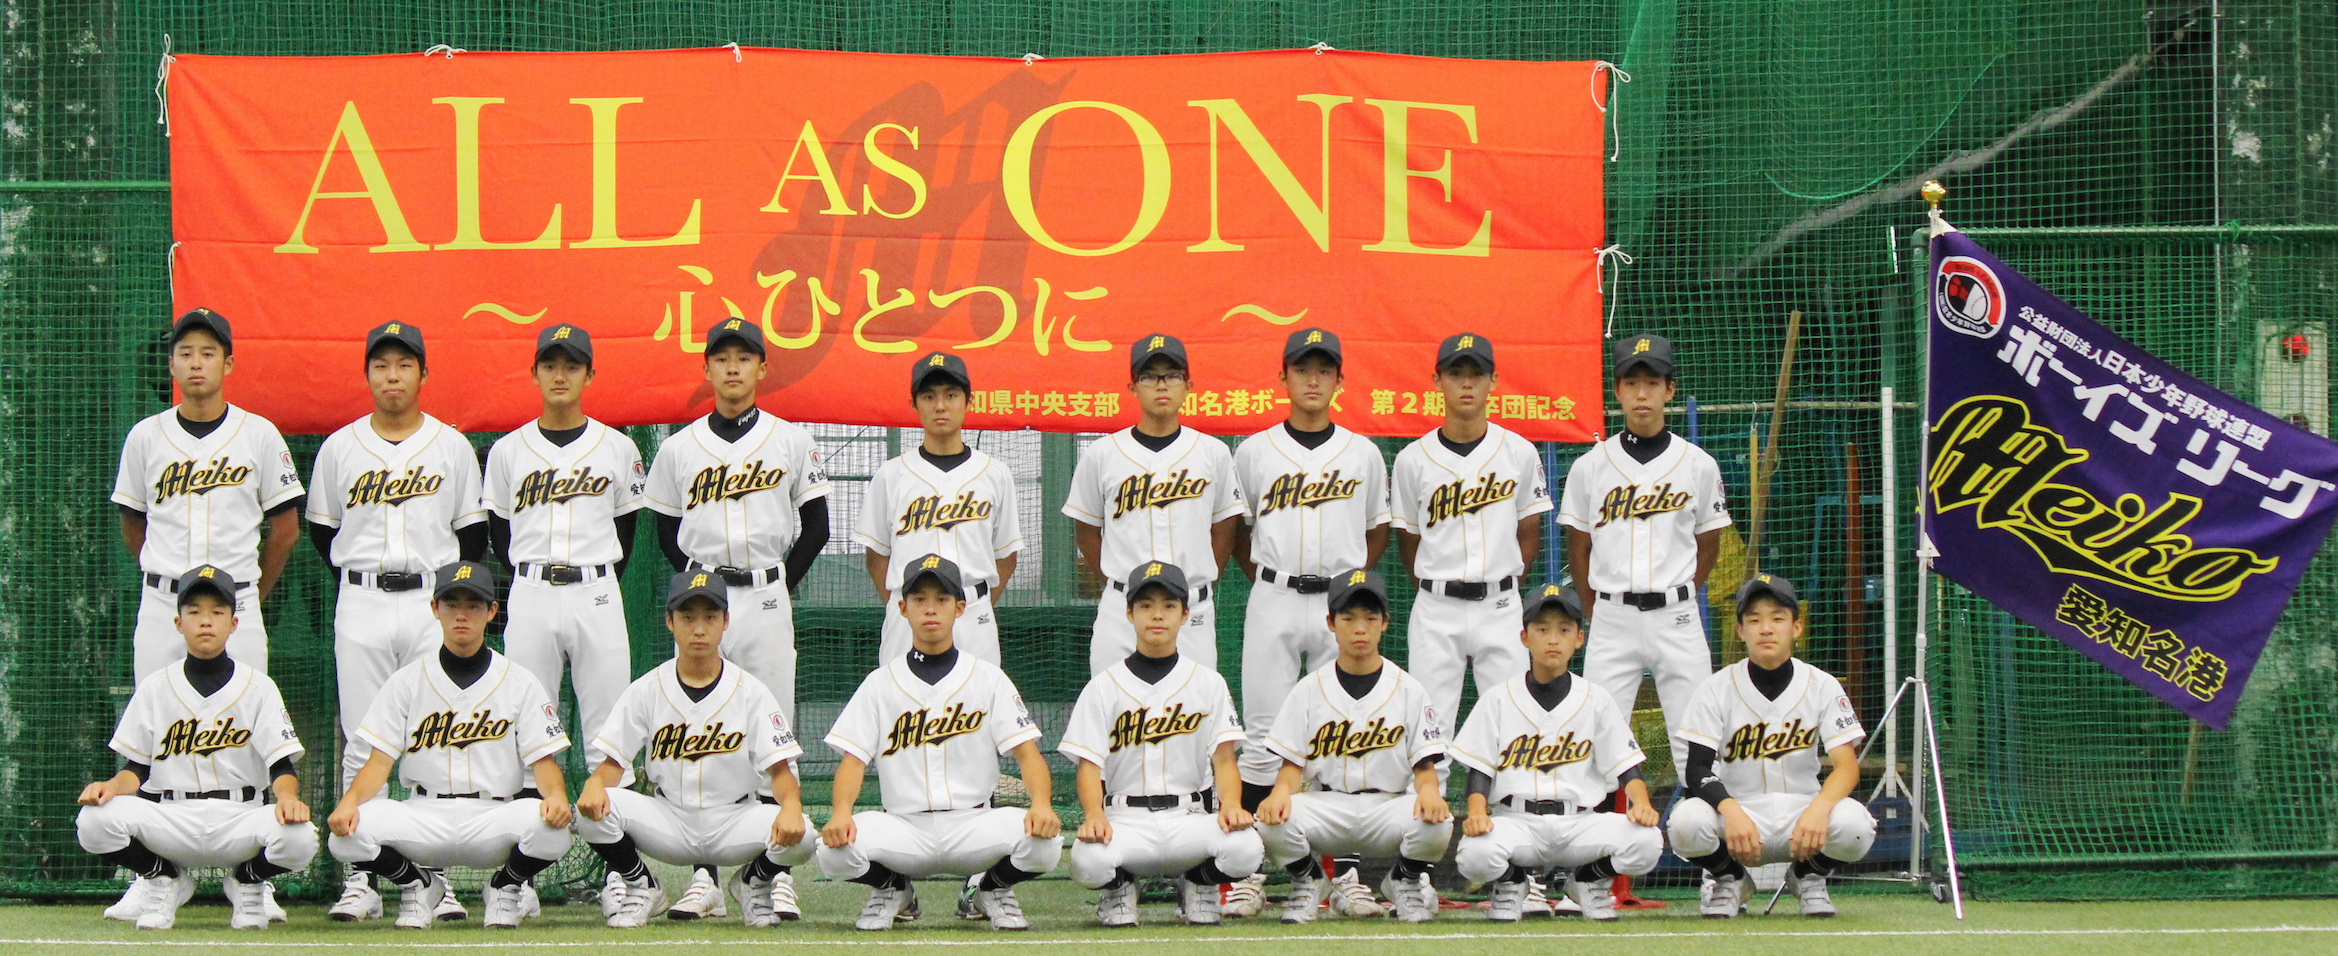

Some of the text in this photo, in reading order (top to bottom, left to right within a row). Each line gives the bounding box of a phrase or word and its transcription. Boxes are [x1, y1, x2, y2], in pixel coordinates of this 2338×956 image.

[274, 93, 1493, 257] ALL AS ONE
[653, 265, 1113, 356] 心ひとつに
[967, 390, 1121, 418] 知県中央支部
[1370, 389, 1577, 420] 第2期卒団記念
[155, 456, 252, 505] Meiko
[346, 465, 445, 510] Meiko
[514, 466, 613, 514] Meiko
[686, 460, 787, 511] Meiko
[1113, 468, 1211, 520] Meiko
[1259, 469, 1363, 518] Meiko
[1426, 472, 1518, 529] Meiko
[1929, 394, 2280, 601] Meiko
[896, 490, 993, 537] Meiko
[1595, 483, 1692, 529] Meiko
[2056, 583, 2228, 702] 愛知名港
[154, 718, 251, 762] Meiko
[406, 709, 514, 753] Meiko
[650, 722, 747, 763] Meiko
[881, 702, 988, 758] Meiko
[1109, 703, 1211, 753] Meiko
[1306, 717, 1406, 761] Meiko
[1723, 718, 1819, 764] Meiko
[1498, 732, 1593, 774] Meiko
